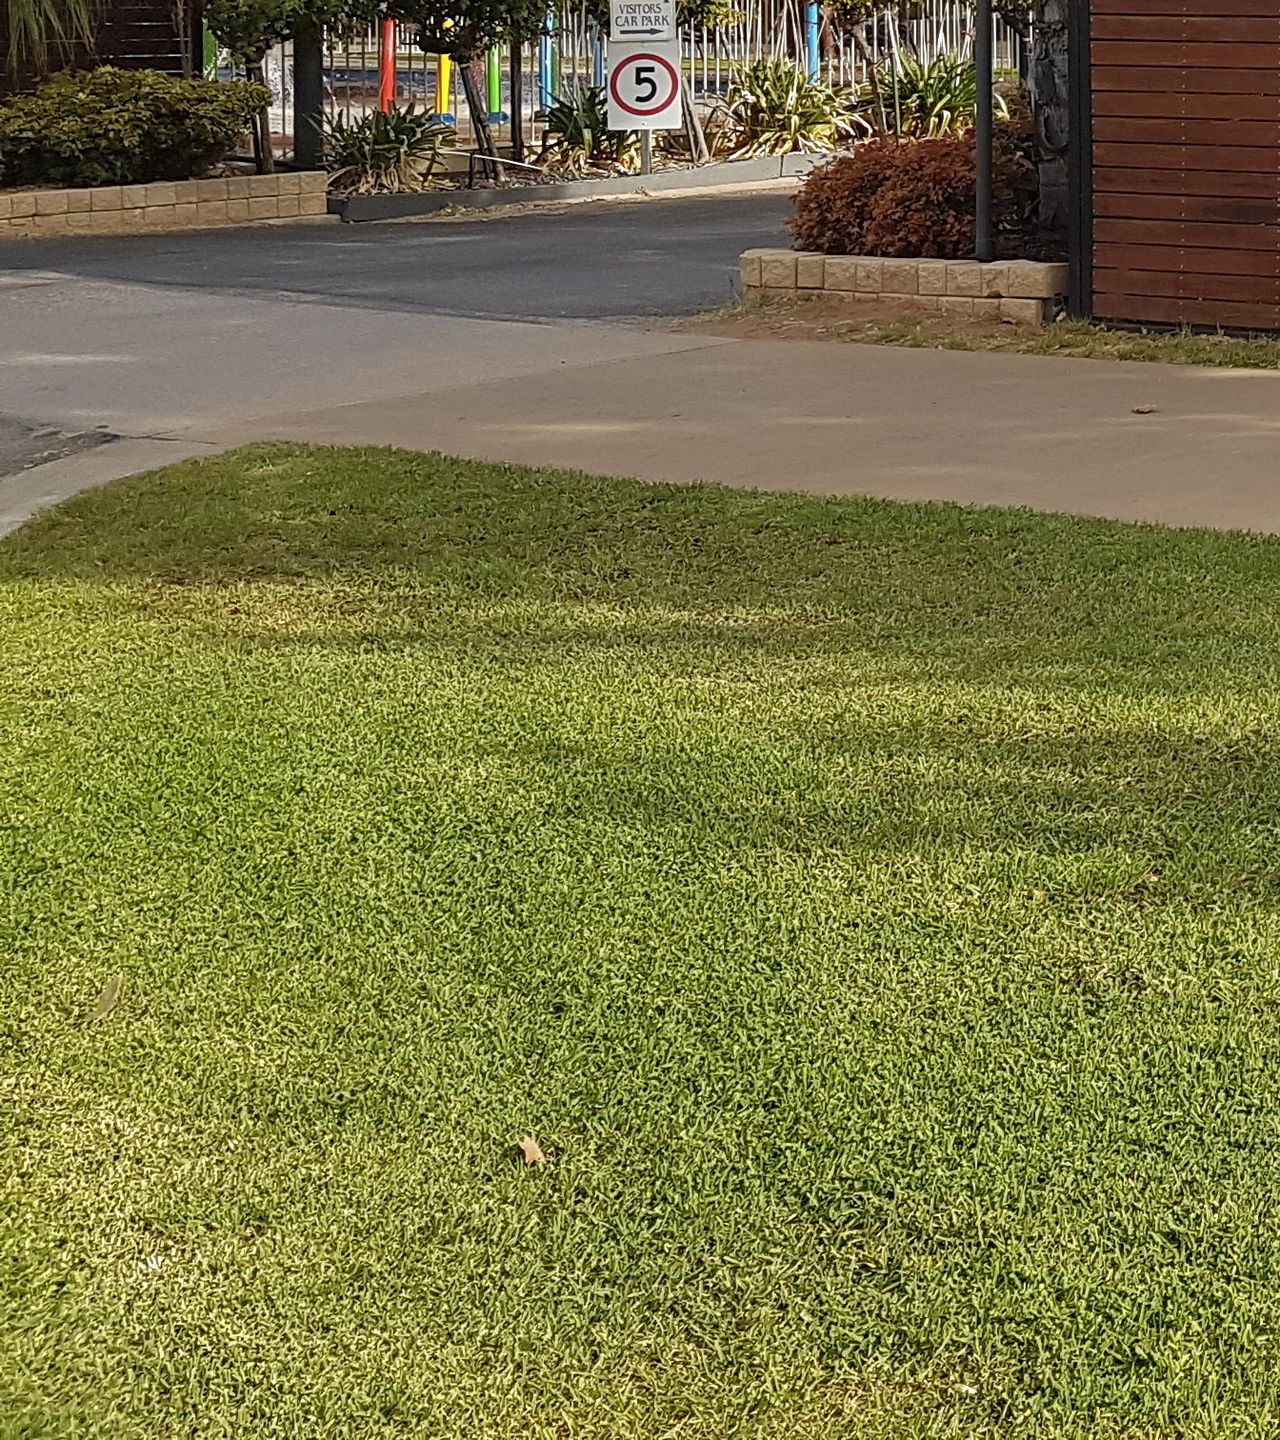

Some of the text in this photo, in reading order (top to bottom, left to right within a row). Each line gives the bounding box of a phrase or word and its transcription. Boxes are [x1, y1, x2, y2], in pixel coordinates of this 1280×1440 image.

[618, 3, 662, 15] VISITORS
[615, 15, 670, 27] CAR PARK
[635, 66, 657, 103] 5
